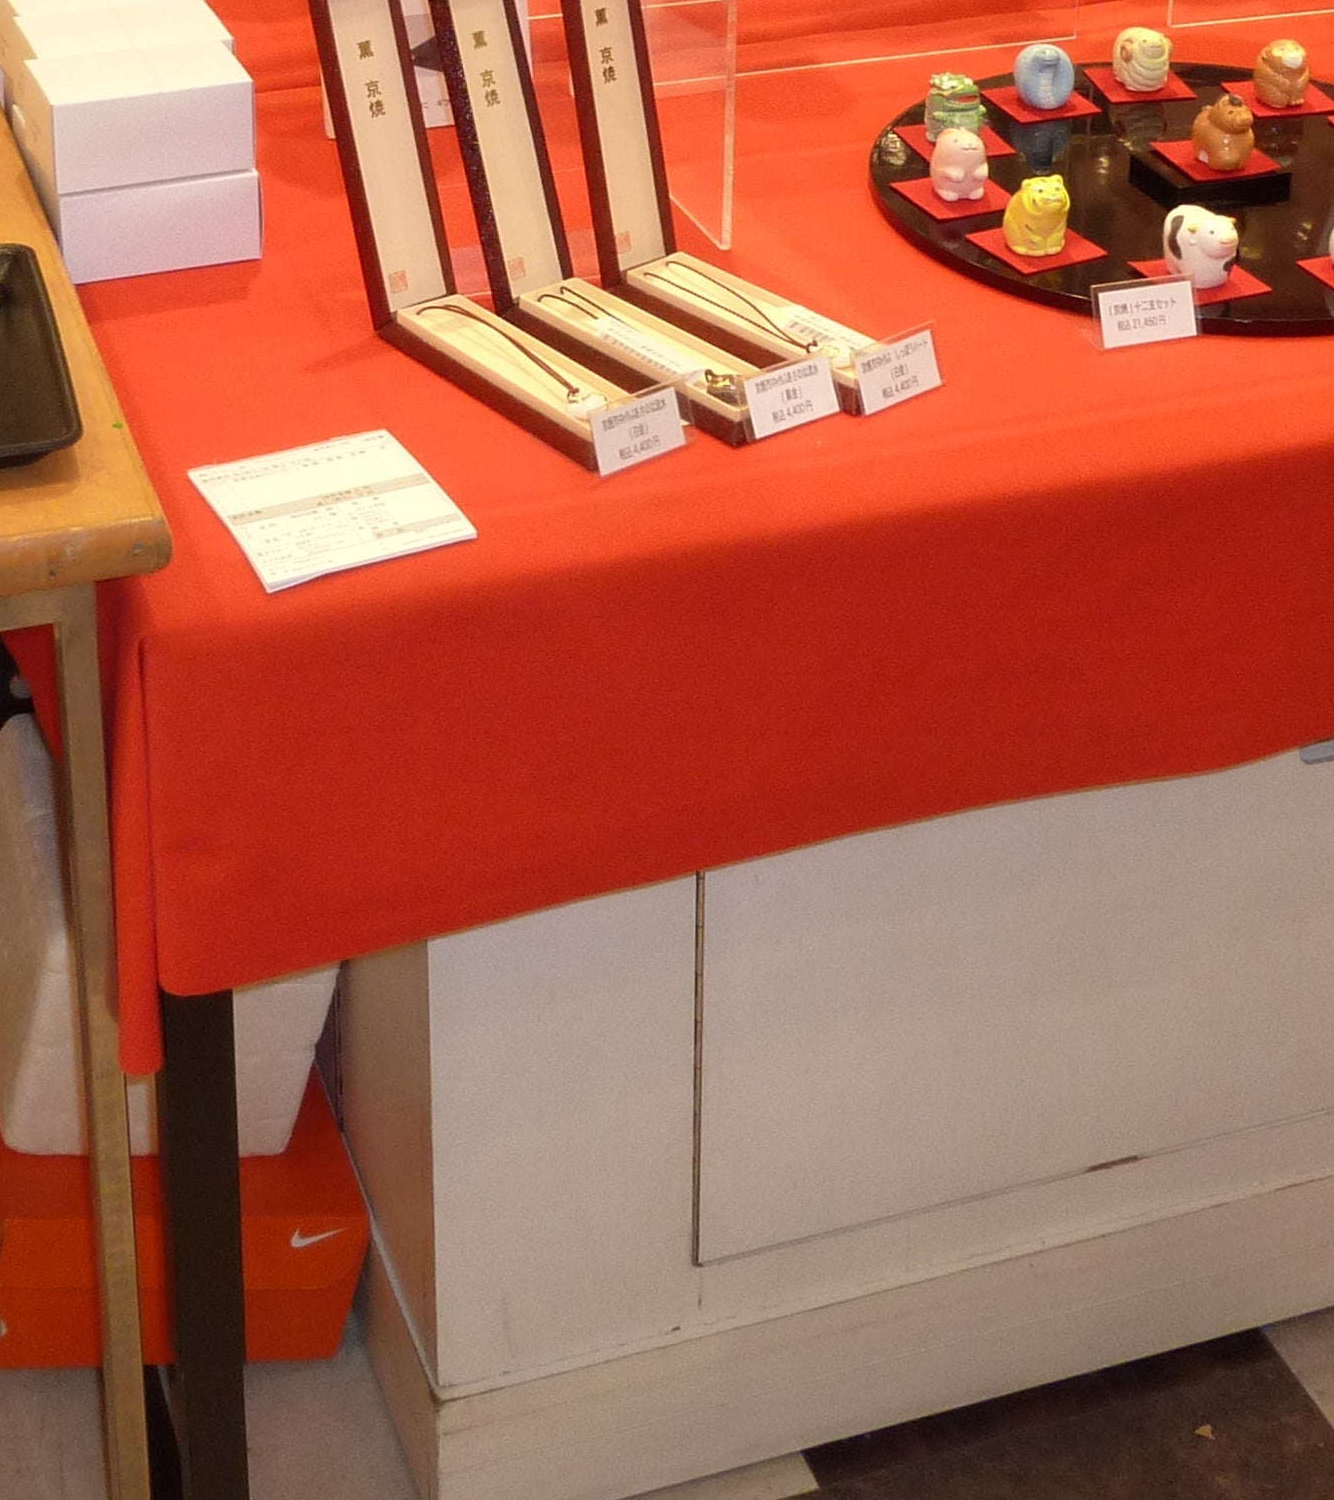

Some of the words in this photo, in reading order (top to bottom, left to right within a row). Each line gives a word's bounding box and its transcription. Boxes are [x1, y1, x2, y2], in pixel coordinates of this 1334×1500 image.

[599, 46, 617, 84] 京焼
[364, 80, 386, 118] 京焼
[480, 70, 500, 107] 京焼
